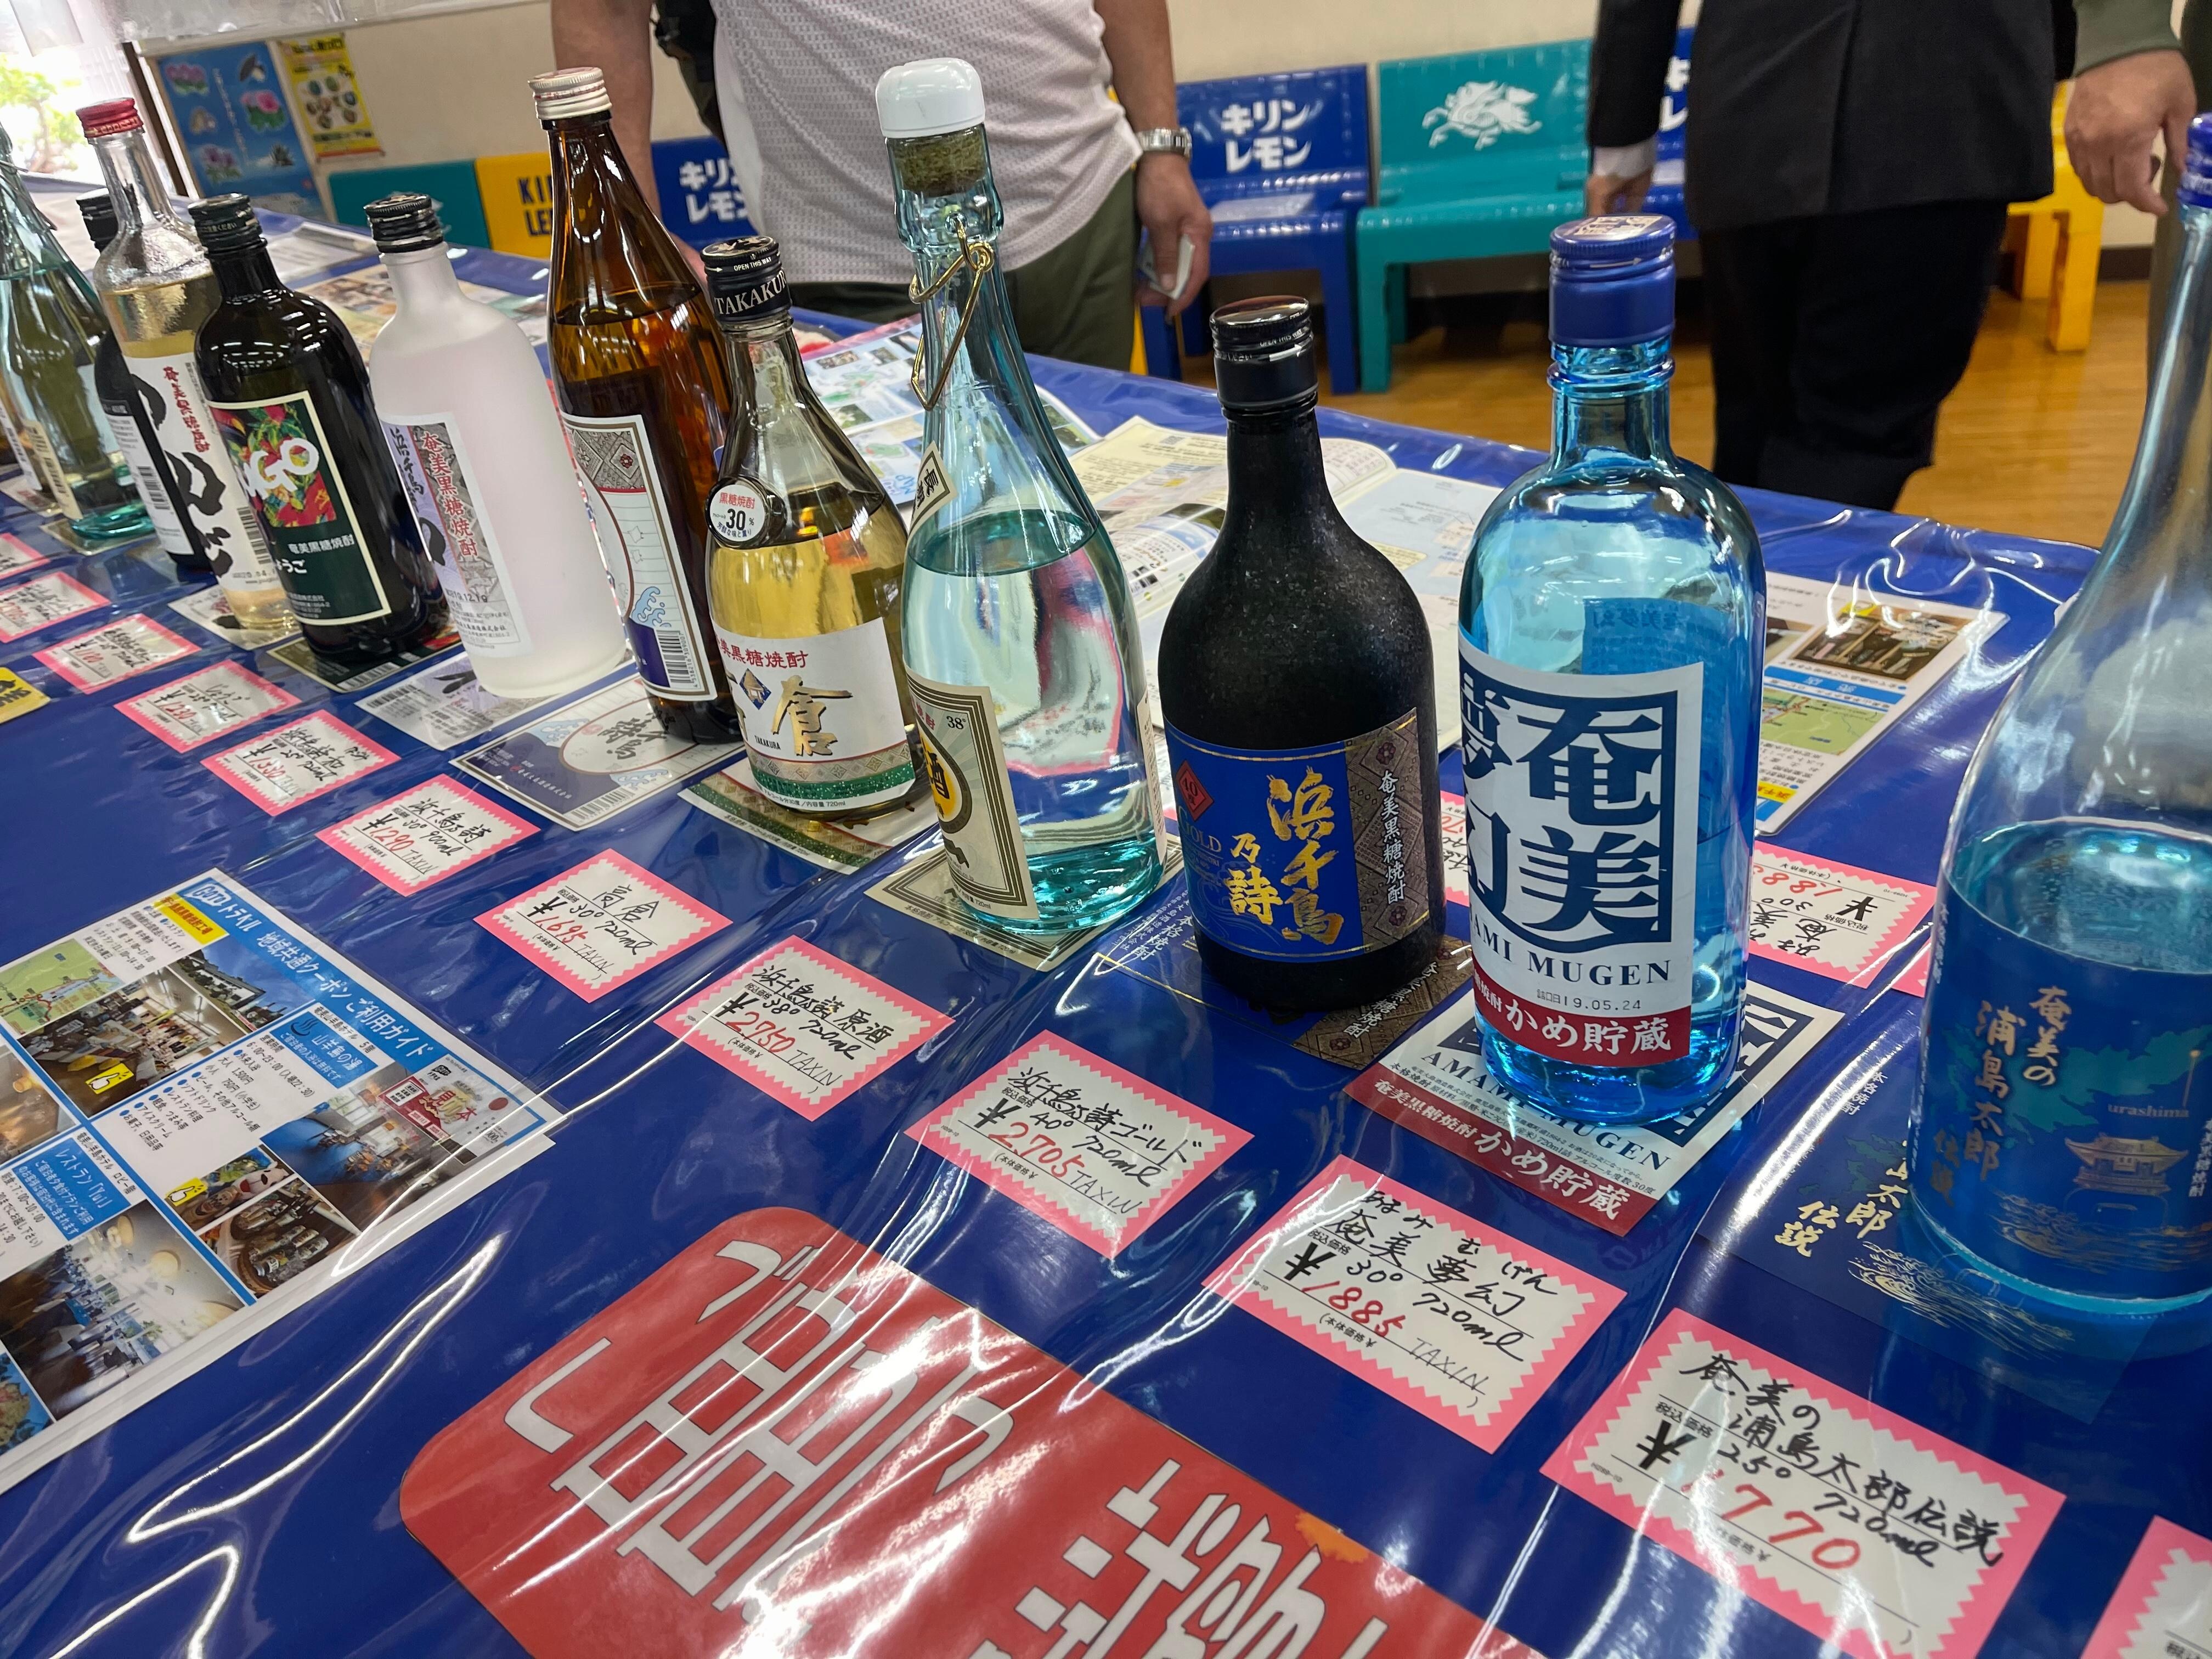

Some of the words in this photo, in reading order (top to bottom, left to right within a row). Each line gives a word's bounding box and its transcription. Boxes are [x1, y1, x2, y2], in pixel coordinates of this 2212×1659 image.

[1221, 99, 1311, 135] キリン
[679, 159, 738, 190] キリ
[1225, 137, 1311, 173] レモン
[733, 262, 749, 272] OPEN
[750, 259, 761, 269] THIS
[761, 256, 772, 265] WAY
[421, 431, 478, 558] 奄美黒糖焼酎
[719, 492, 755, 510] 黒糖焼酎
[726, 508, 746, 531] 30
[754, 735, 781, 751] TAKAKURA
[403, 819, 427, 830] 30°
[419, 831, 464, 856] 900ml
[408, 798, 492, 845] 浜千鳥乃詩
[1178, 805, 1222, 853] GOLD
[1378, 770, 1407, 905] 奄美黒糖焼酎
[1516, 706, 1663, 934] 奄美
[401, 849, 439, 875] TAXIN
[1266, 765, 1344, 945] 浜千鳥
[1223, 832, 1283, 926] 乃詩
[592, 883, 659, 923] 高倉
[975, 899, 992, 910] 720ml
[1824, 913, 1870, 932] 税込価格
[569, 903, 604, 919] 30°
[594, 919, 653, 956] 720ml
[573, 944, 614, 974] TAXIN
[1527, 951, 1672, 987] MUGEN
[218, 903, 262, 932] トラベル
[256, 930, 352, 1000] 地域共通クーポン
[345, 997, 435, 1058] ご利用ガイド
[744, 982, 772, 1001] 税込価格
[751, 964, 838, 1020] 浜千鳥乃詩
[833, 1008, 895, 1045] 原酒
[798, 1019, 862, 1060] 720ml
[1505, 1001, 1672, 1054] かめ貯蔵
[2022, 985, 2072, 1087] 奄美の
[312, 1034, 364, 1071] 山羊島の湯
[786, 1049, 842, 1086] TAXIN
[1390, 1062, 1432, 1090] 本格焼酎
[1963, 999, 2027, 1181] 浦島太郎
[180, 1083, 217, 1114] ソフトドリンク
[1001, 1086, 1037, 1109] 税込価格
[2106, 1103, 2190, 1119] urashima
[137, 1105, 174, 1139] アイスクリーム
[1029, 1111, 1074, 1130] 40°
[1072, 1135, 1162, 1188] 720ml
[1374, 1079, 1479, 1139] 奄美黒糖焼酎
[1474, 1130, 1631, 1221] かめ貯蔵
[1068, 1169, 1144, 1215] TAXIN
[1307, 1228, 1353, 1256] 税込価格
[1458, 1237, 1481, 1256] む
[1774, 1199, 1841, 1257] 伝説
[1324, 1209, 1421, 1268] 奄美
[1426, 1254, 1526, 1317] 夢幻
[1346, 1260, 1404, 1285] 30°
[1412, 1291, 1526, 1363] 720ml
[1408, 1336, 1489, 1391] TAXIN
[1679, 1352, 1821, 1429] 奄美の
[1655, 1400, 1717, 1440] 税込価格
[1729, 1408, 2004, 1567] 浦島太郎伝説
[1814, 1490, 1941, 1569] 720ml
